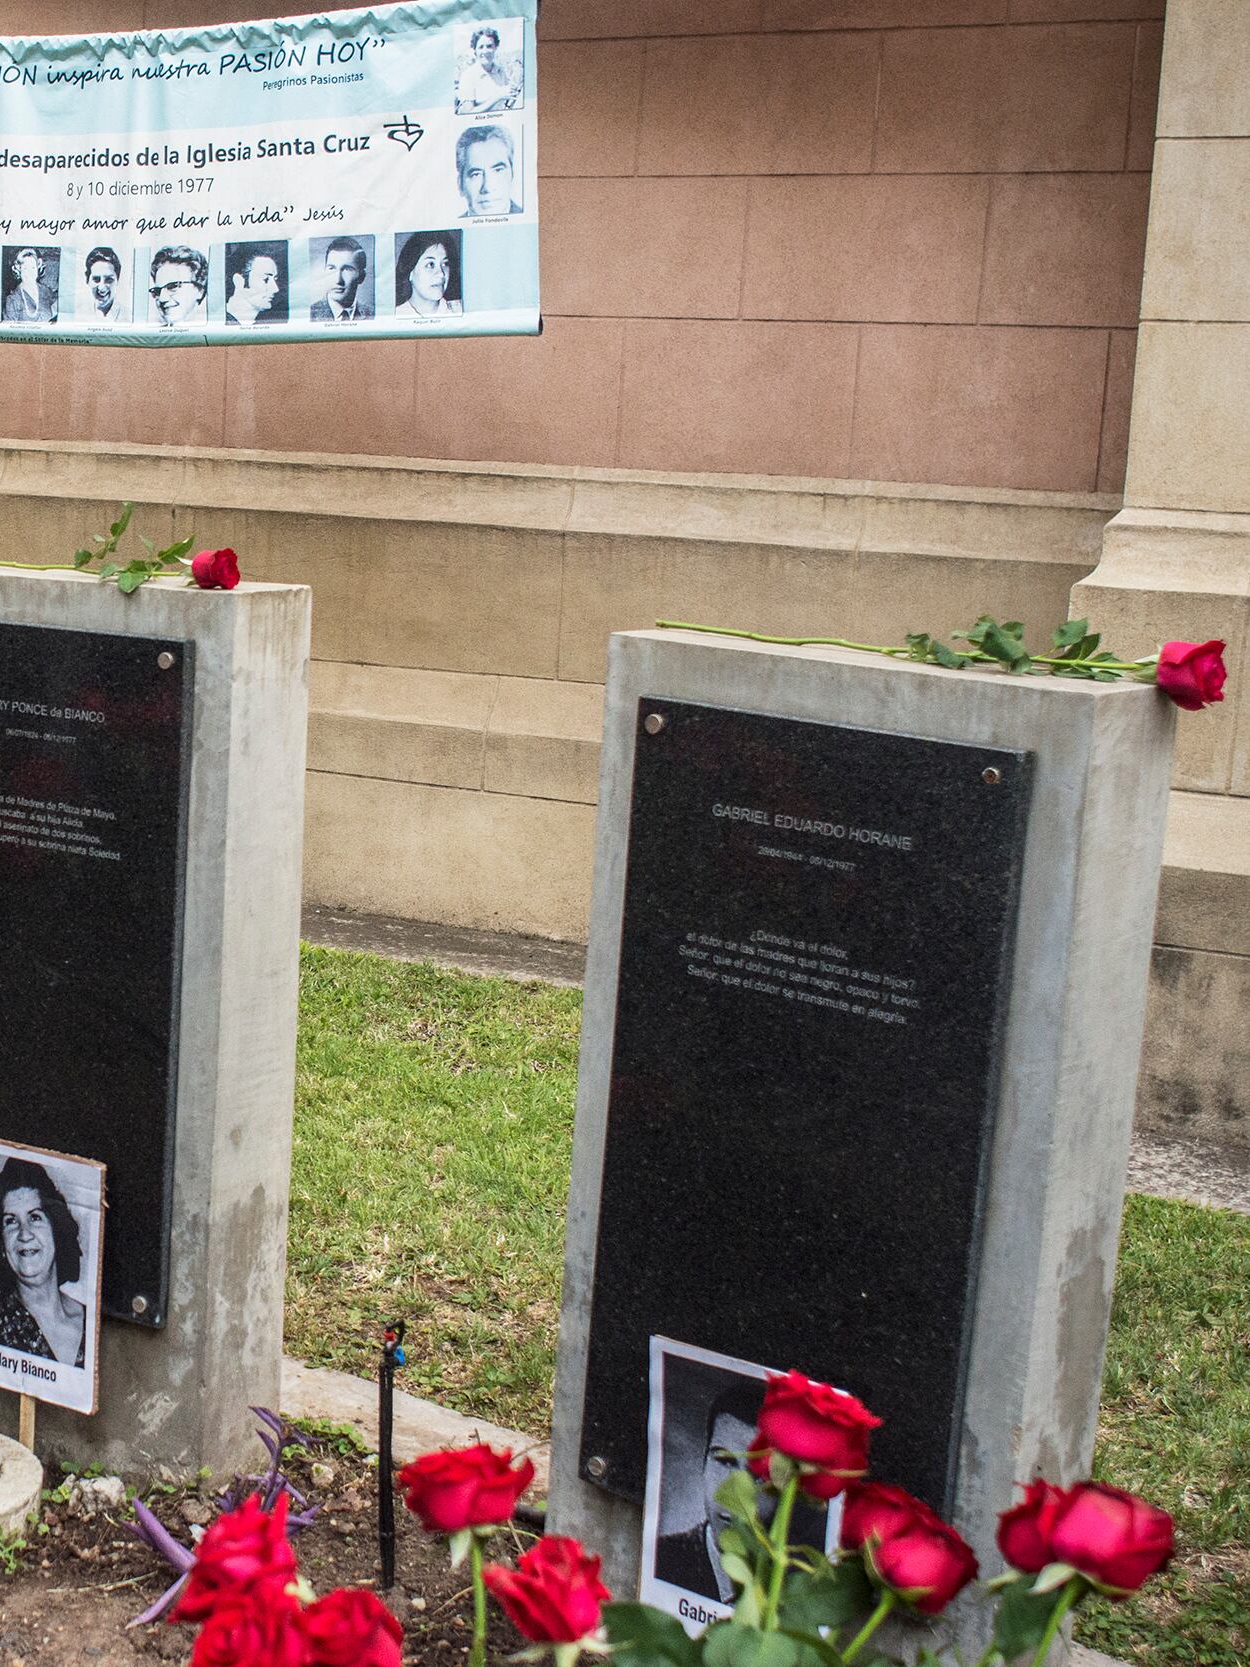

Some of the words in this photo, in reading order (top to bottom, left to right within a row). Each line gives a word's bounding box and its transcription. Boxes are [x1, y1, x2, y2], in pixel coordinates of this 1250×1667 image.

[47, 63, 124, 89] inspira
[132, 59, 211, 80] nuestra
[219, 40, 306, 75] PASIÓN
[316, 36, 386, 66] HOY”
[262, 78, 307, 91] Peregrinos
[310, 72, 364, 86] Pasionistas
[136, 147, 159, 166] de
[163, 145, 180, 165] la
[186, 141, 251, 169] Iglesia
[256, 138, 315, 159] Santa
[323, 134, 370, 154] Cruz
[66, 182, 74, 197] 8
[76, 185, 83, 200] y
[87, 181, 104, 196] 10
[109, 179, 173, 197] diciembre
[178, 177, 214, 193] 1977
[20, 218, 76, 236] mayor
[82, 218, 128, 231] amor
[136, 215, 167, 235] que
[172, 211, 209, 229] dar
[217, 211, 233, 226] la
[240, 205, 294, 224] vida”
[302, 204, 344, 222] Jesús
[11, 700, 48, 717] PONCE
[64, 707, 106, 724] BIANCO
[5, 794, 16, 804] de
[16, 796, 45, 809] Madres
[46, 801, 57, 811] de
[57, 802, 80, 815] Plaza
[80, 807, 92, 817] de
[36, 814, 46, 823] su
[47, 814, 61, 826] hija
[712, 803, 771, 826] GABRIEL
[774, 814, 845, 839] EDUARDO
[848, 827, 912, 851] HORANE
[40, 826, 50, 836] de
[50, 828, 67, 839] dos
[27, 838, 37, 847] su
[38, 840, 66, 852] sobrina
[67, 844, 87, 855] nieta
[686, 932, 697, 942] el
[698, 935, 722, 947] dolor
[724, 941, 737, 952] de
[740, 943, 755, 955] las
[757, 948, 796, 964] madres
[797, 957, 818, 969] que
[819, 960, 849, 975] lloran
[850, 969, 859, 978] a
[860, 970, 880, 983] sus
[882, 975, 916, 991] hijos?
[712, 954, 733, 966] que
[733, 959, 745, 969] el
[745, 961, 771, 975] dolor
[773, 968, 787, 979] no
[789, 971, 808, 984] sea
[846, 985, 879, 1000] opaco
[881, 992, 890, 1004] y
[721, 974, 741, 986] que
[742, 979, 753, 989] el
[754, 980, 780, 995] dolor
[782, 987, 795, 999] se
[797, 991, 850, 1011] transmute
[851, 1004, 866, 1015] en
[21, 1359, 57, 1382] Bianco
